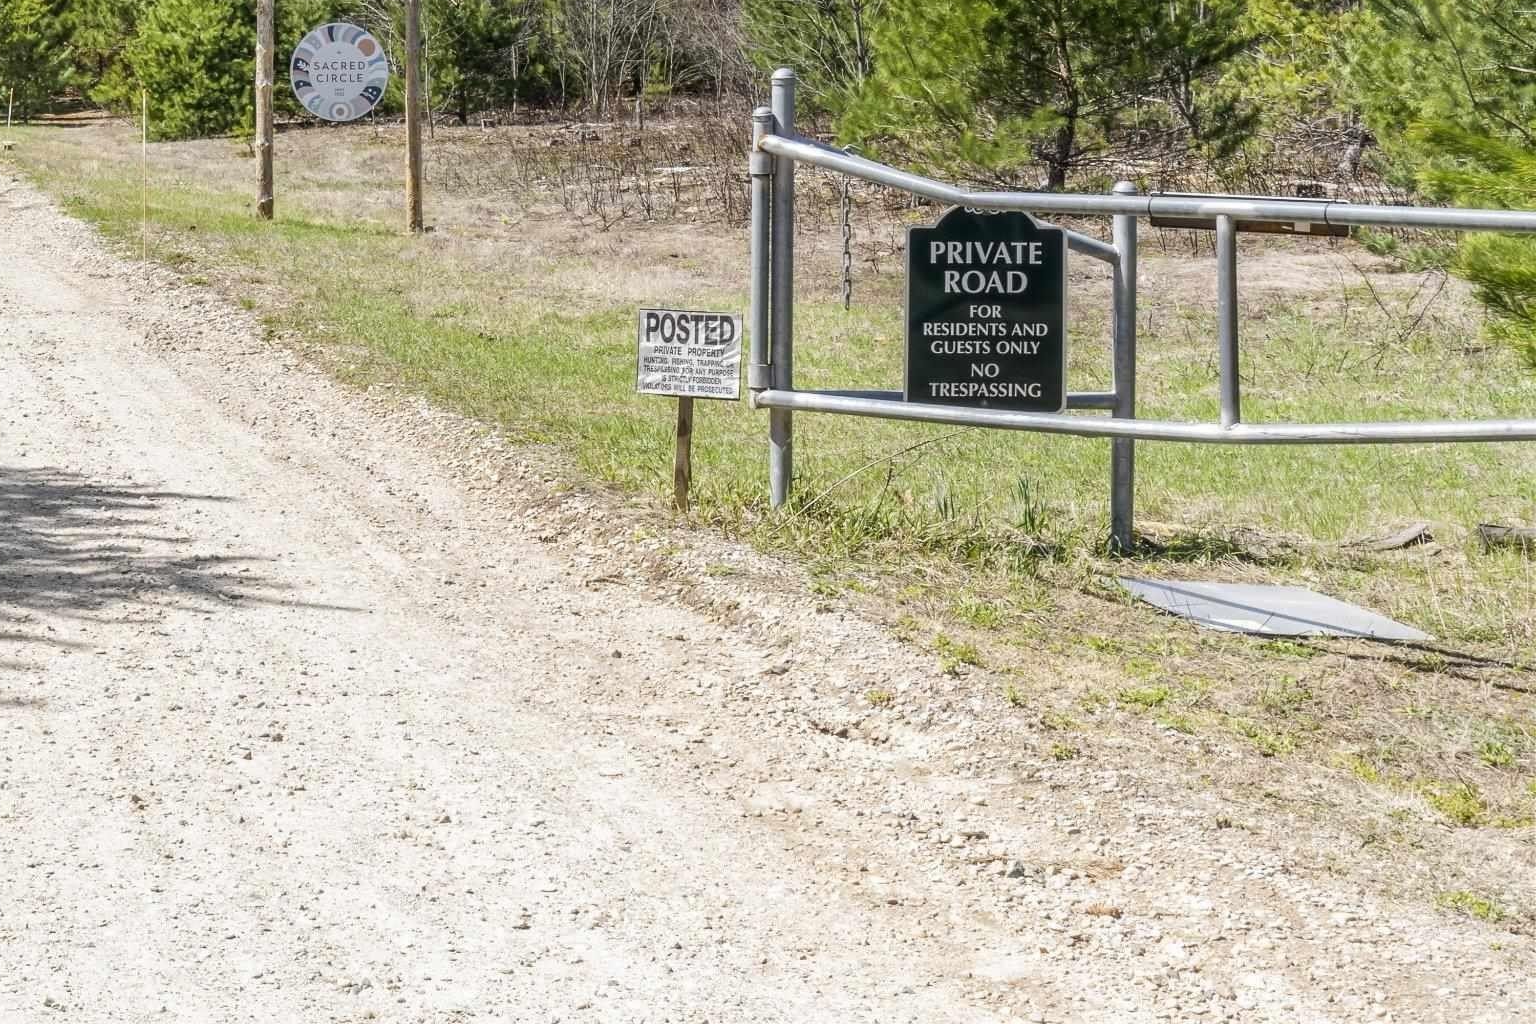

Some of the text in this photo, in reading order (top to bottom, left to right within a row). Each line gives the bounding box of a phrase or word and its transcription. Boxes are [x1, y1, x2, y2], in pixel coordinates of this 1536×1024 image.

[313, 61, 365, 70] SACRED
[316, 73, 364, 83] CIRCLE
[930, 241, 1043, 265] PRIVATE
[944, 270, 1028, 294] ROAD
[969, 304, 1002, 318] FOR
[646, 312, 735, 345] POSTED
[923, 322, 1049, 337] RESIDENTS AND
[654, 345, 725, 357] PRIVATE PROPERTY
[930, 340, 1040, 355] GUESTS ONLY
[695, 368, 706, 376] ANY
[970, 362, 1000, 377] NO
[929, 382, 1041, 398] TRESPASSING
